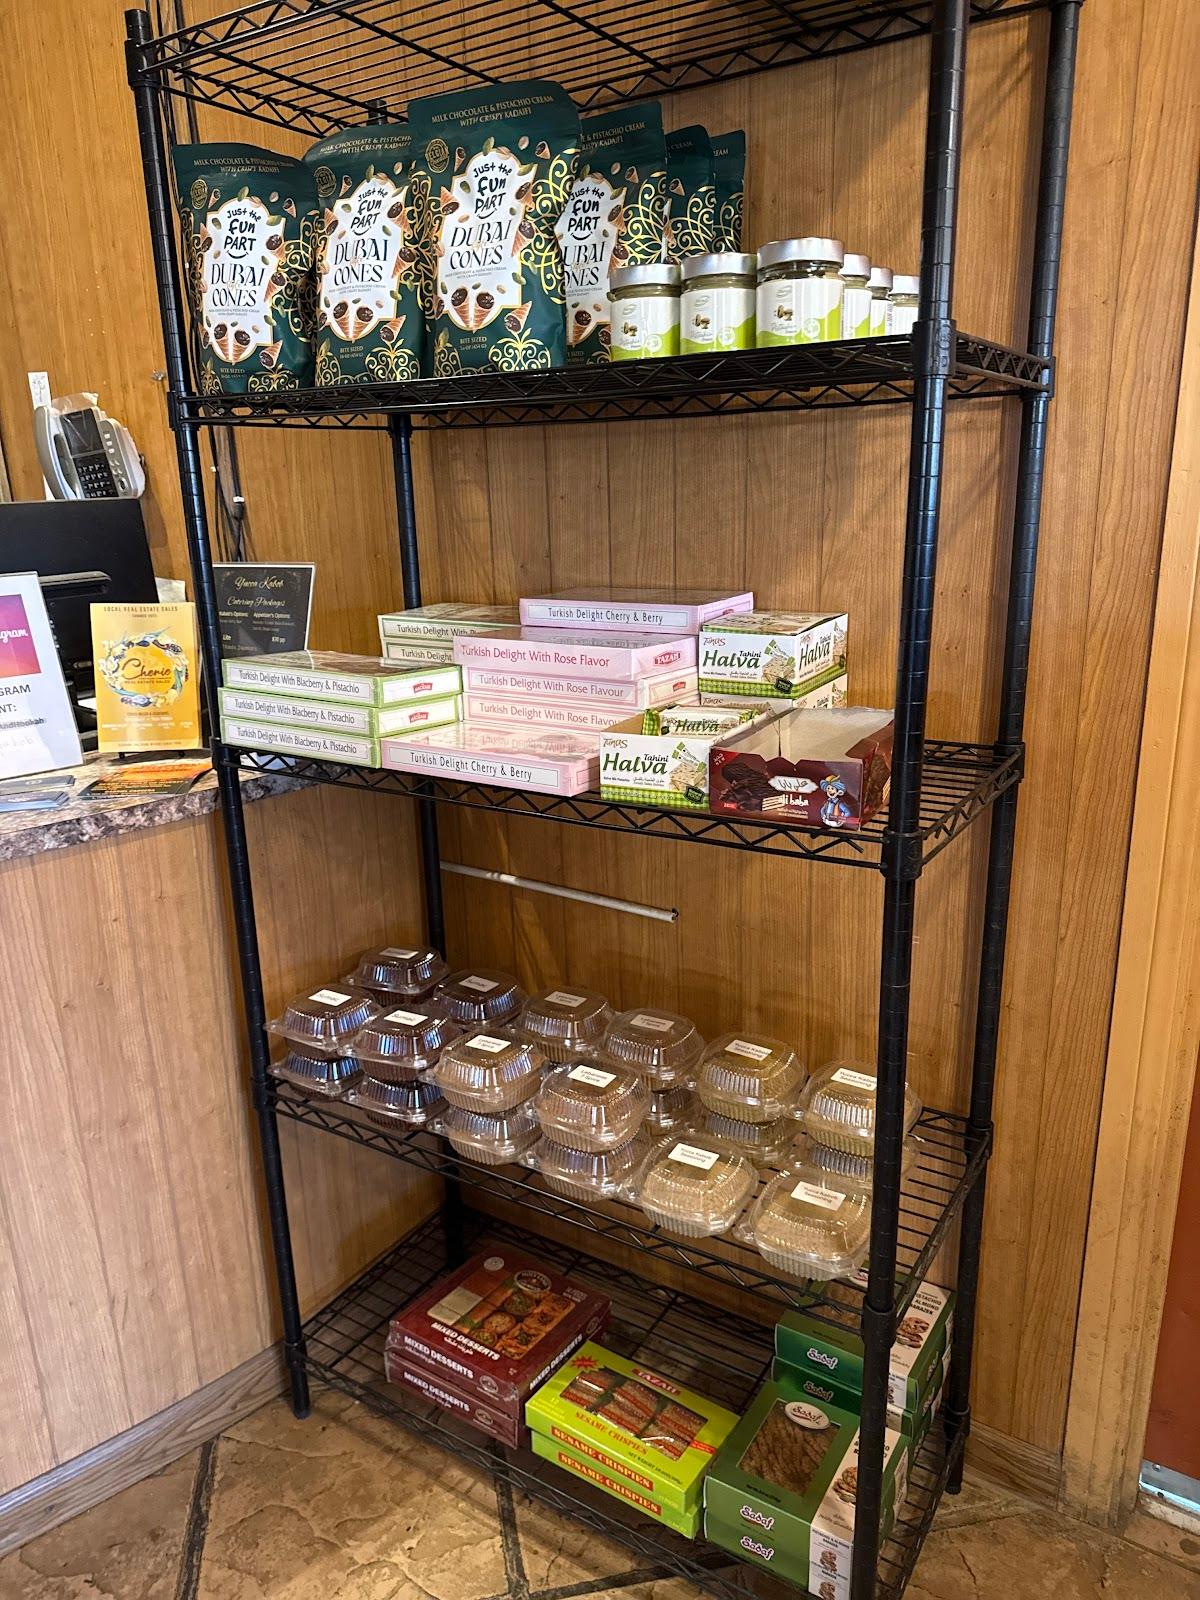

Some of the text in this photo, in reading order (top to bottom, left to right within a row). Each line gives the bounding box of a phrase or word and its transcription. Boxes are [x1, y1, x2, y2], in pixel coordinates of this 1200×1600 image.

[432, 114, 448, 123] MILK
[448, 105, 489, 120] CHOCOLATE
[496, 98, 531, 112] PISTACHIO
[460, 117, 479, 127] WITH
[480, 113, 503, 124] CRISPY
[592, 126, 624, 141] PISTACHIO
[624, 121, 646, 133] CREAM
[335, 137, 371, 150] CHOCOLATE
[361, 143, 383, 152] CRISPY
[474, 192, 507, 214] PART
[350, 212, 380, 229] PART
[568, 216, 601, 232] PART
[224, 235, 257, 252] PART
[450, 219, 512, 247] DUBAI
[334, 238, 389, 265] DUBAI
[450, 245, 503, 270] CONES
[563, 241, 607, 267] UBAI
[211, 263, 266, 287] DUBAI
[334, 263, 383, 286] CONES
[563, 266, 600, 289] ONES
[212, 288, 257, 308] CONES
[549, 607, 573, 619] Turkish
[576, 609, 603, 622] Delight
[605, 610, 631, 624] Cherry
[642, 612, 663, 625] Berry
[397, 624, 421, 634] Turkish
[423, 626, 449, 637] Delight
[401, 648, 452, 662] Turkish Delight
[461, 644, 610, 667] Turkish Delight With Rose Flavor
[702, 649, 761, 669] Halva
[739, 650, 762, 658] Tahini
[799, 640, 831, 670] Halva
[239, 669, 258, 681] Turkish
[260, 672, 280, 686] Delight
[281, 675, 295, 686] With
[296, 677, 324, 691] Blacberry
[332, 681, 360, 694] Pistachio
[480, 674, 624, 697] Turkish Delight With Rose Flavour
[235, 698, 254, 710] Turkish
[255, 701, 275, 715] Delight
[276, 704, 291, 715] With
[292, 706, 319, 720] Blacberry
[327, 711, 355, 724] Pistachio
[480, 702, 588, 724] Turkish Delight With Rose
[237, 727, 256, 739] Turkish
[257, 730, 278, 744] Delight
[279, 733, 293, 744] With
[294, 735, 321, 750] Blacberry
[330, 740, 357, 754] Pistachio
[410, 752, 532, 782] Turkish Delight Cherry & Berry
[602, 752, 668, 775] Halva
[643, 753, 669, 763] Tahini
[430, 1321, 459, 1339] MIXED
[456, 1332, 501, 1361] DESSERTS
[403, 1335, 430, 1356] MIXED
[430, 1350, 474, 1379] DESSERTS
[530, 1365, 552, 1391] MIXED
[550, 1332, 583, 1370] DESSERTS
[807, 1348, 838, 1369] Sadaf
[403, 1370, 429, 1390] MIXED
[428, 1384, 470, 1412] DESSERTS
[803, 1381, 834, 1401] Sadaf
[793, 1406, 822, 1424] Sadaf
[575, 1410, 648, 1455] SESAME CRISPIES
[553, 1427, 596, 1457] SESAME
[598, 1452, 652, 1489] CRISPIES
[561, 1453, 659, 1513] SESAME CRISPIES
[741, 1506, 774, 1530] Sadaf
[741, 1536, 774, 1560] Sadaf
